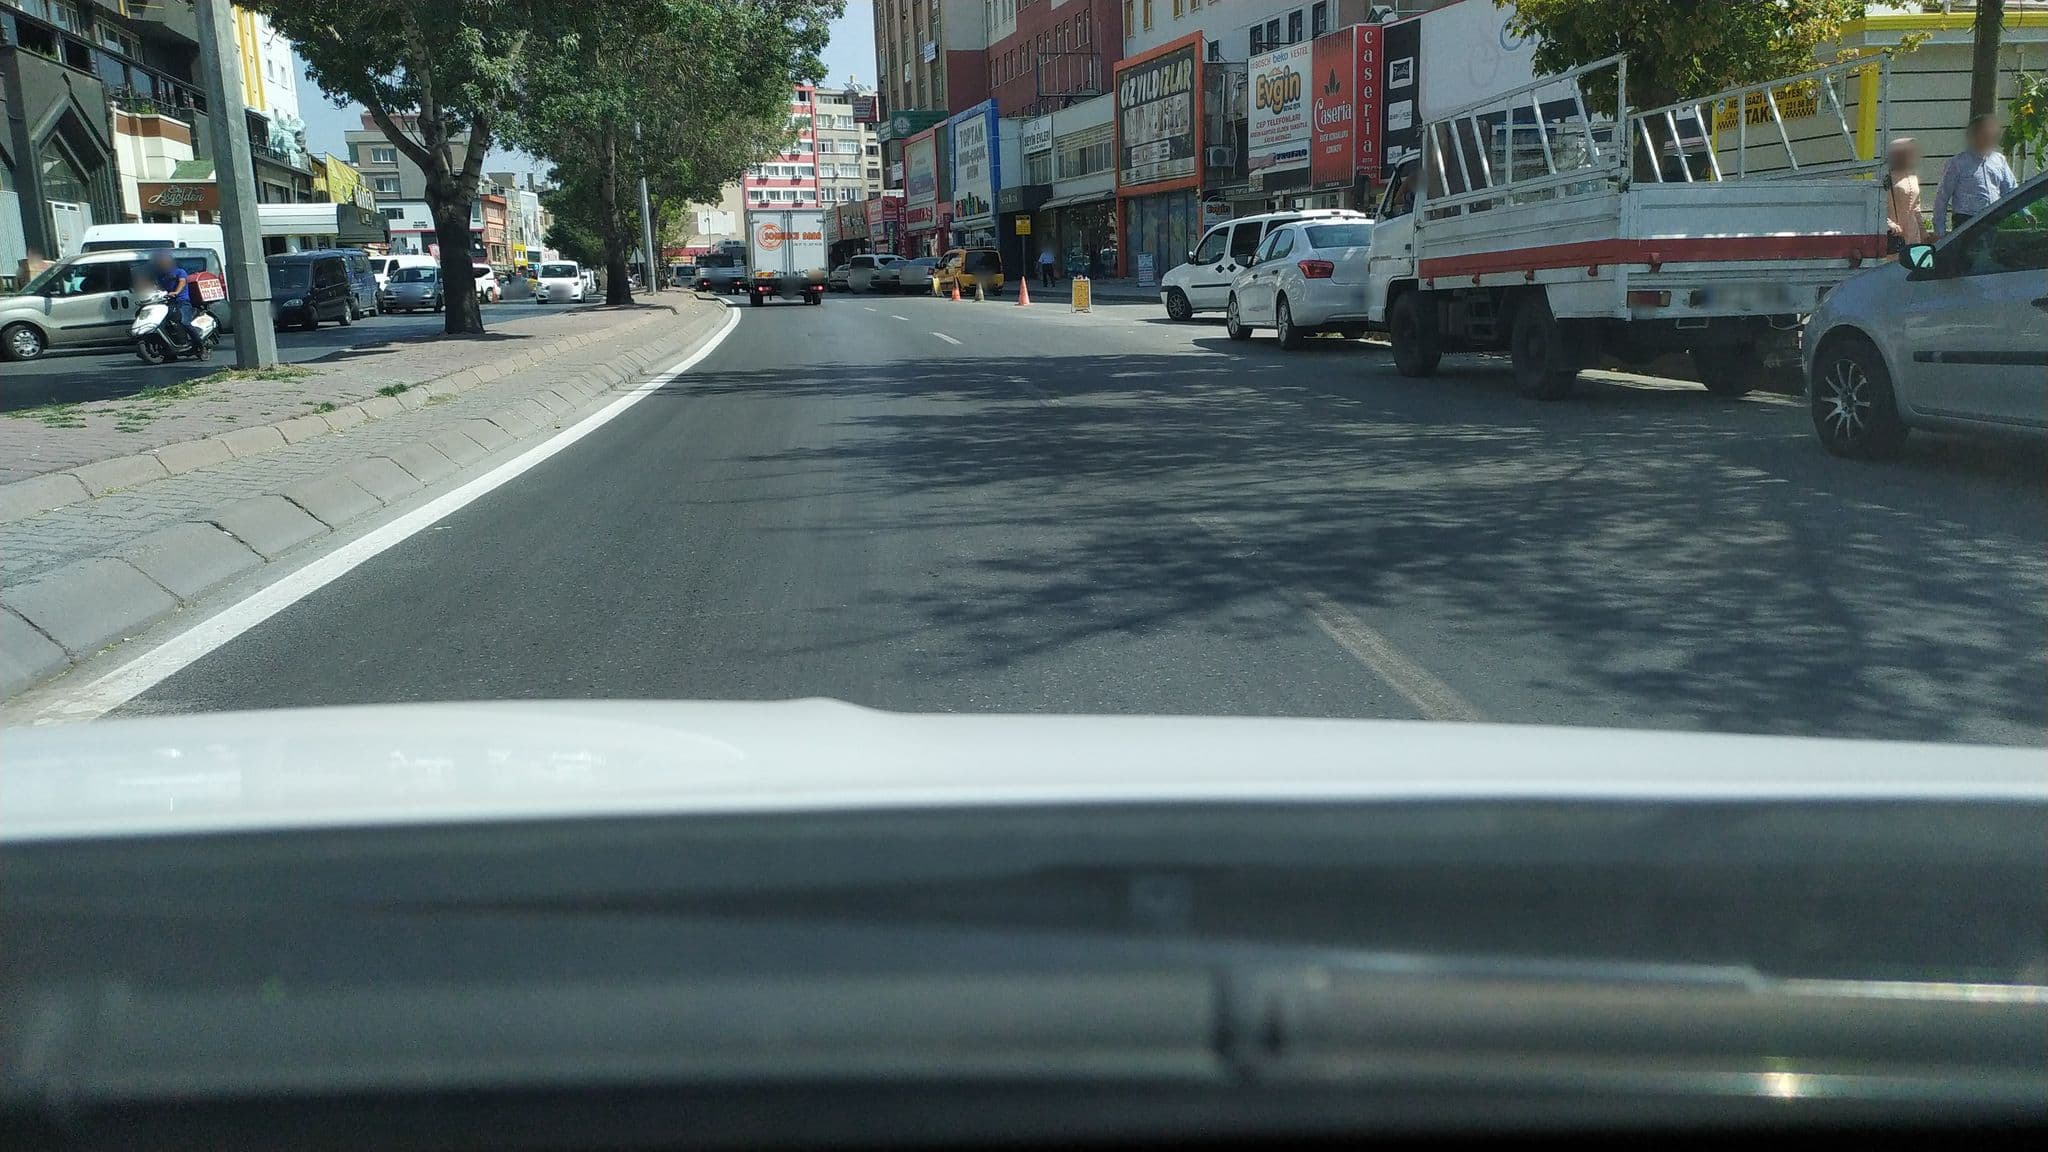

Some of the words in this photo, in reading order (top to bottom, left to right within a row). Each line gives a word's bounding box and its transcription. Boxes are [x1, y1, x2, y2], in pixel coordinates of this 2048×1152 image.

[1272, 51, 1289, 63] beko
[1291, 46, 1308, 58] VESTEL
[1256, 64, 1301, 115] Evgin
[1313, 97, 1352, 132] Caseria
